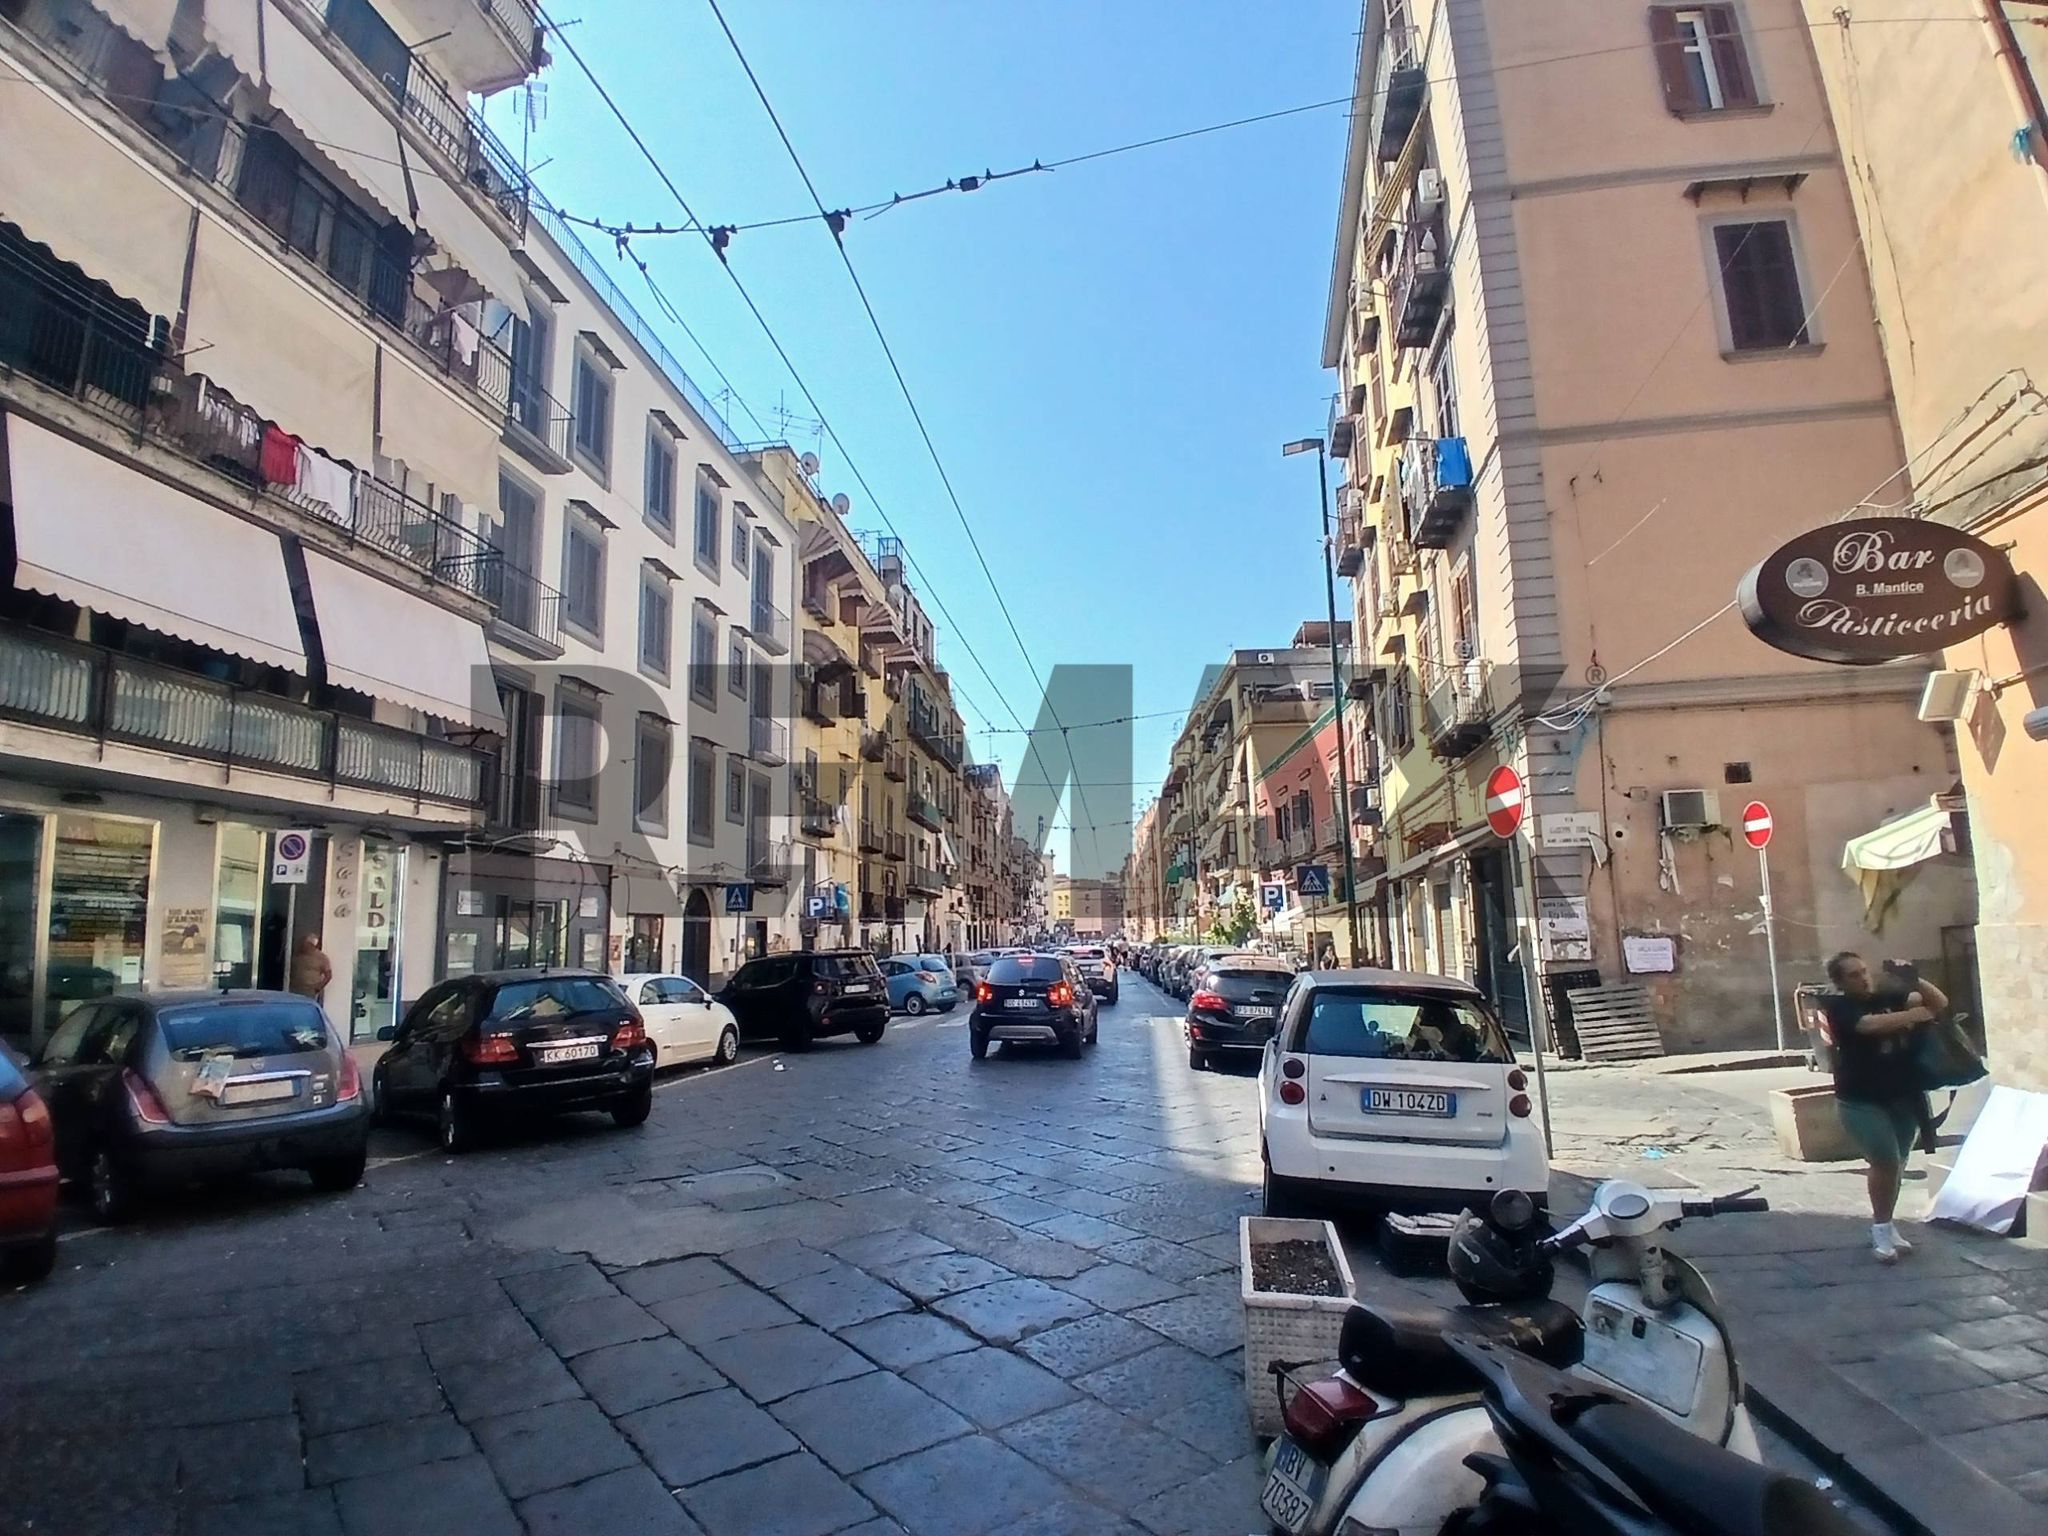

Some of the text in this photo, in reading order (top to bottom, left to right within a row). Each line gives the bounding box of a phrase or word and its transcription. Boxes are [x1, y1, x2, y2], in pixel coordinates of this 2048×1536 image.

[1832, 530, 1935, 574] Bar
[1856, 580, 1925, 596] B. Mantice
[1796, 591, 1992, 637] Pasticceria
[1264, 887, 1279, 905] P
[809, 898, 823, 916] P
[546, 1045, 597, 1062] KK 60170
[1372, 1091, 1446, 1111] DW 104ZD
[1285, 1445, 1307, 1481] BV
[1263, 1473, 1310, 1527] 70387
